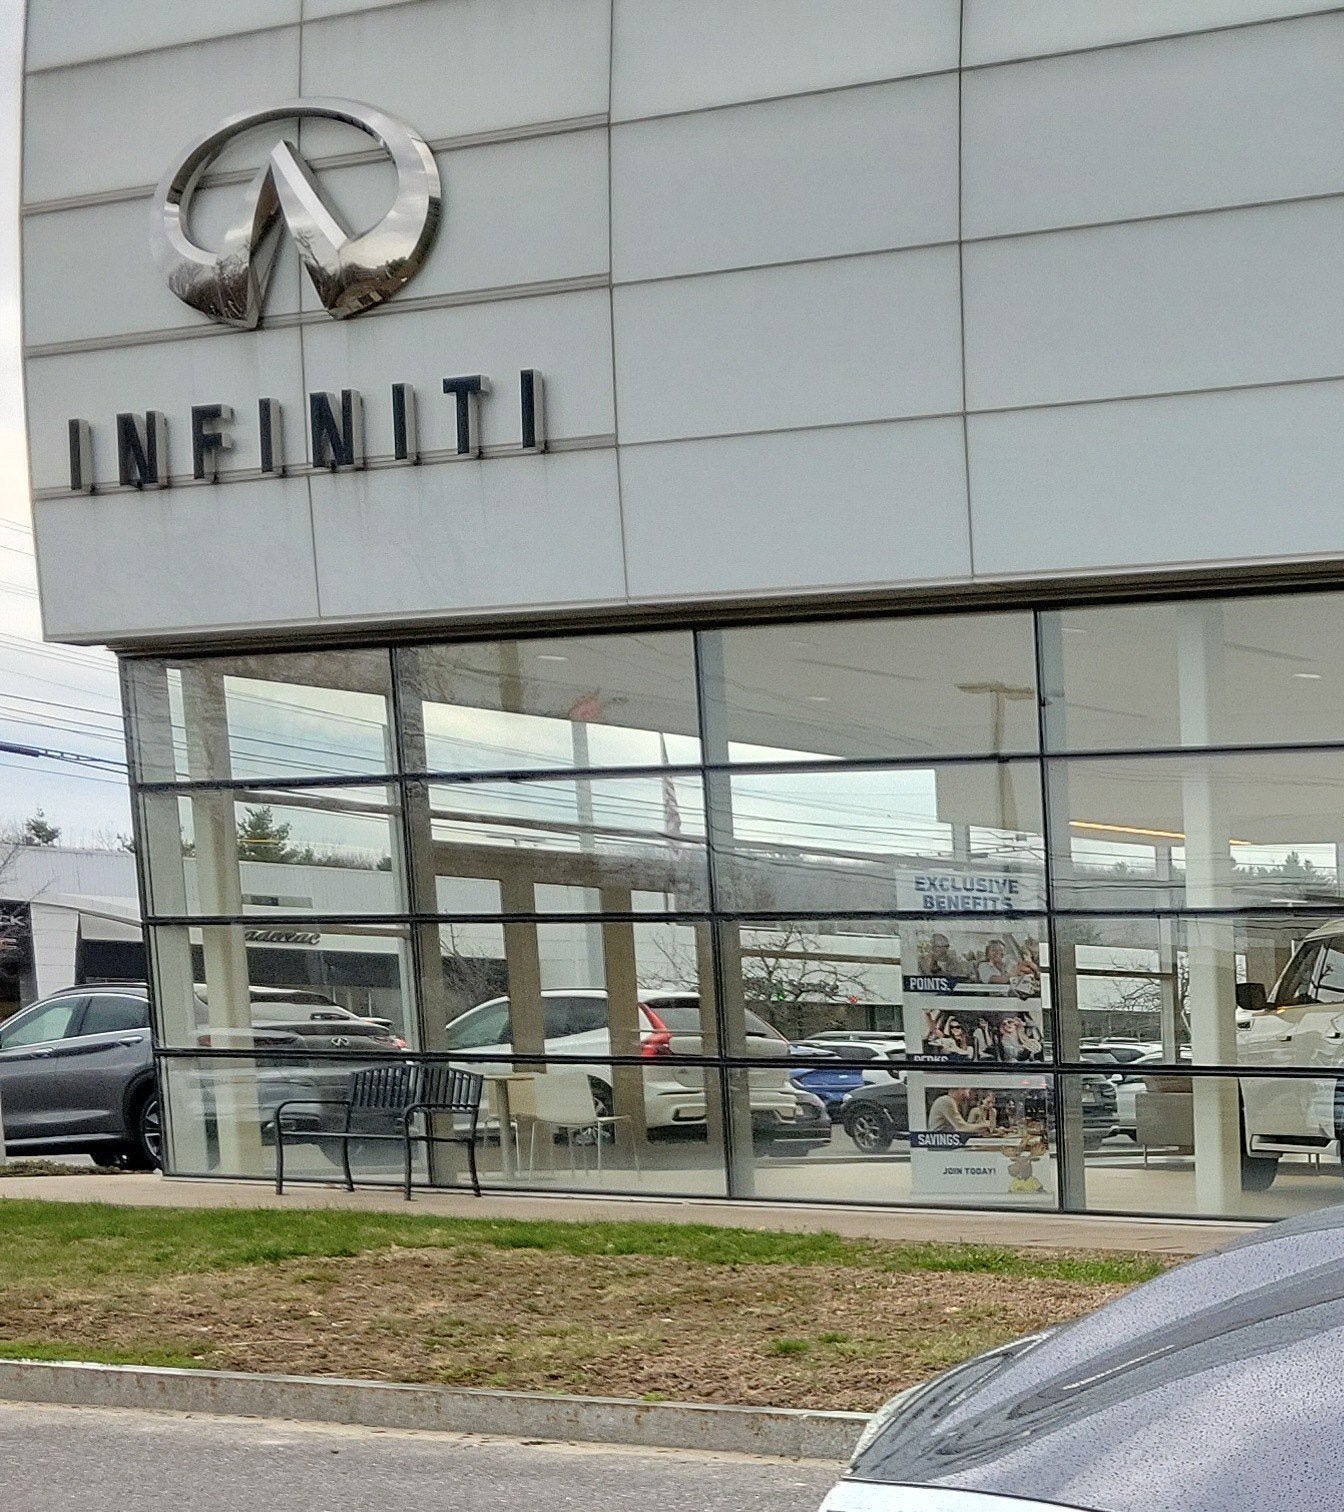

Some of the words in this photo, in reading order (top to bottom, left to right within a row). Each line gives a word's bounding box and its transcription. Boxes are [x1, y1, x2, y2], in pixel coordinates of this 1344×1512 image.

[68, 368, 544, 491] INFINITI
[914, 875, 1019, 894] EXCLUSIVE
[922, 894, 1013, 910] BENEFITS
[943, 1167, 963, 1175] JOIN
[965, 1167, 997, 1175] TODAY!
